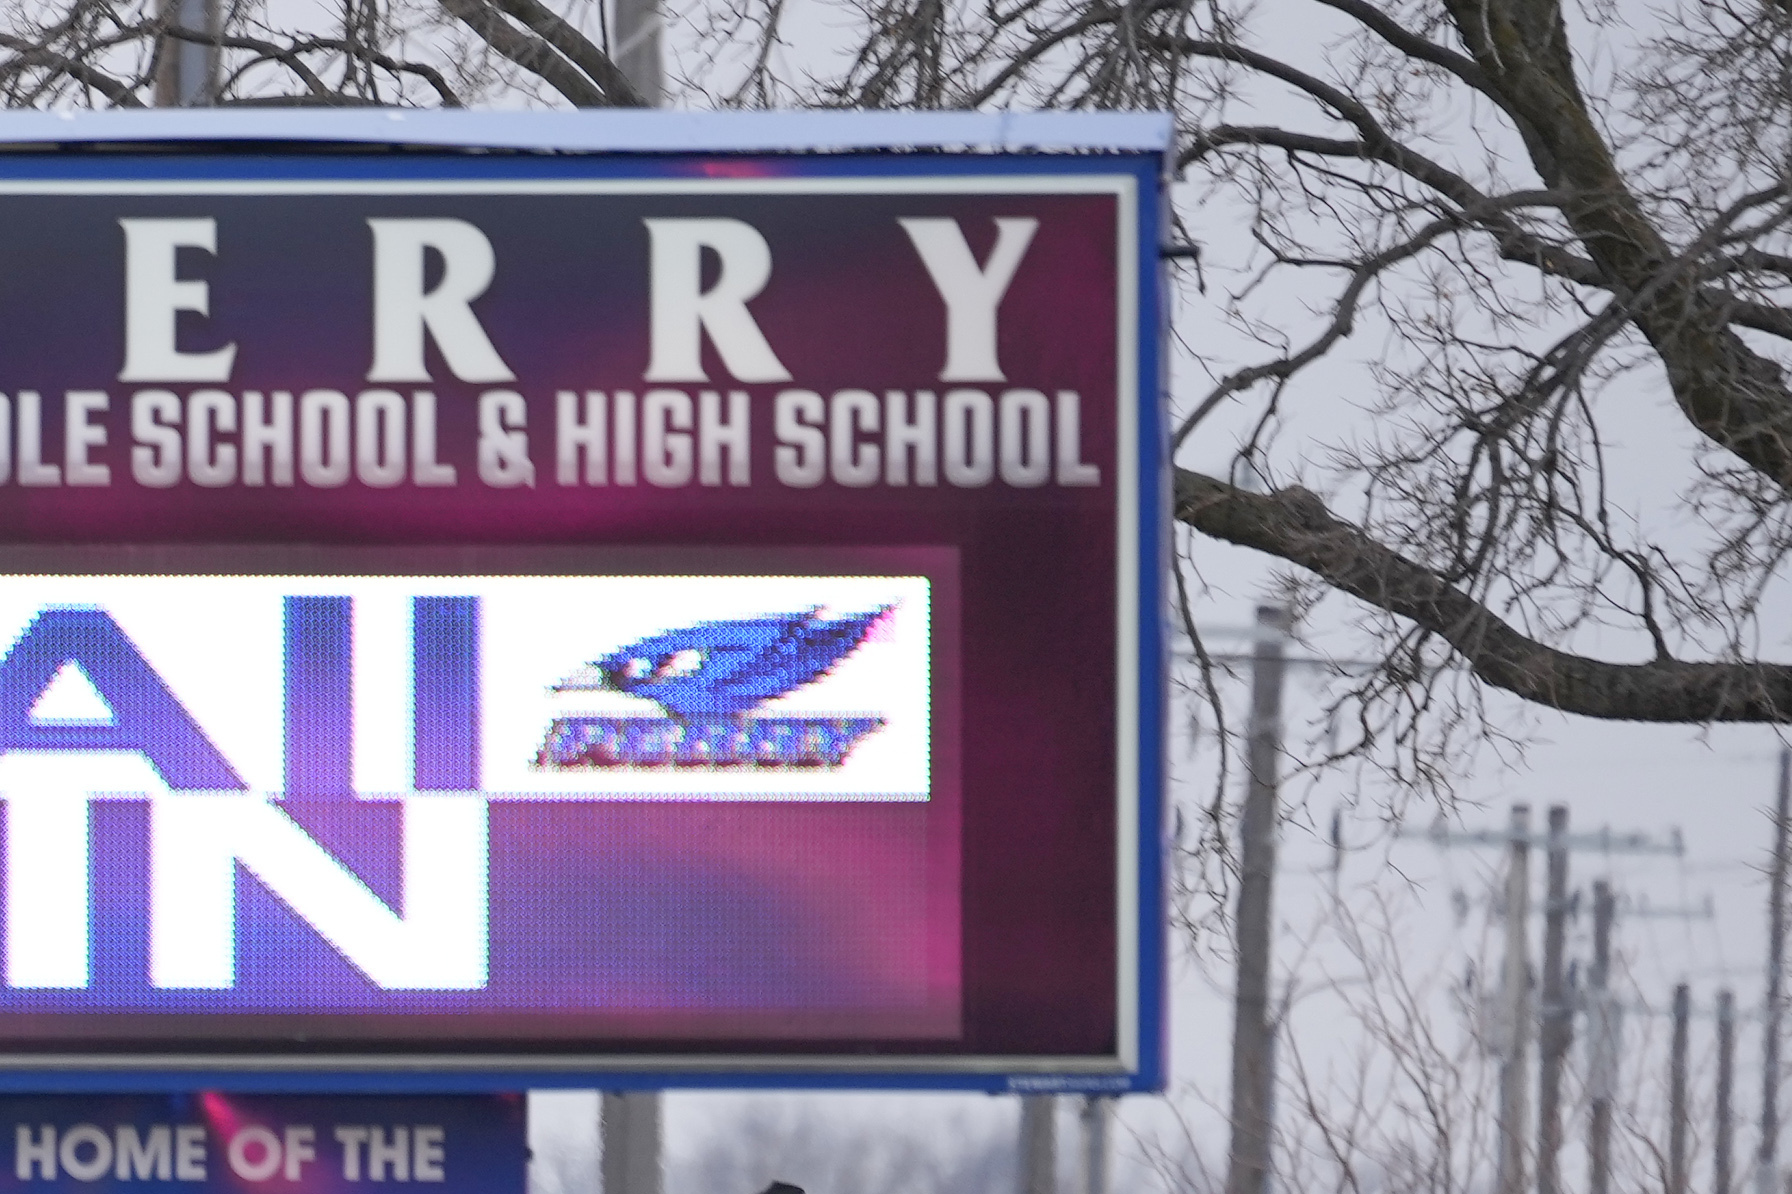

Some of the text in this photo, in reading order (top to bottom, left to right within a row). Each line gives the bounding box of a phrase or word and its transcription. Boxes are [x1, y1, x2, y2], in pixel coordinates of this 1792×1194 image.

[131, 389, 457, 488] SCHOOL
[477, 390, 536, 488] &
[556, 389, 752, 488] HIGH
[774, 390, 1101, 486] SCHOOL
[3, 793, 490, 990] IN
[15, 1124, 445, 1183] HOME OF THE
